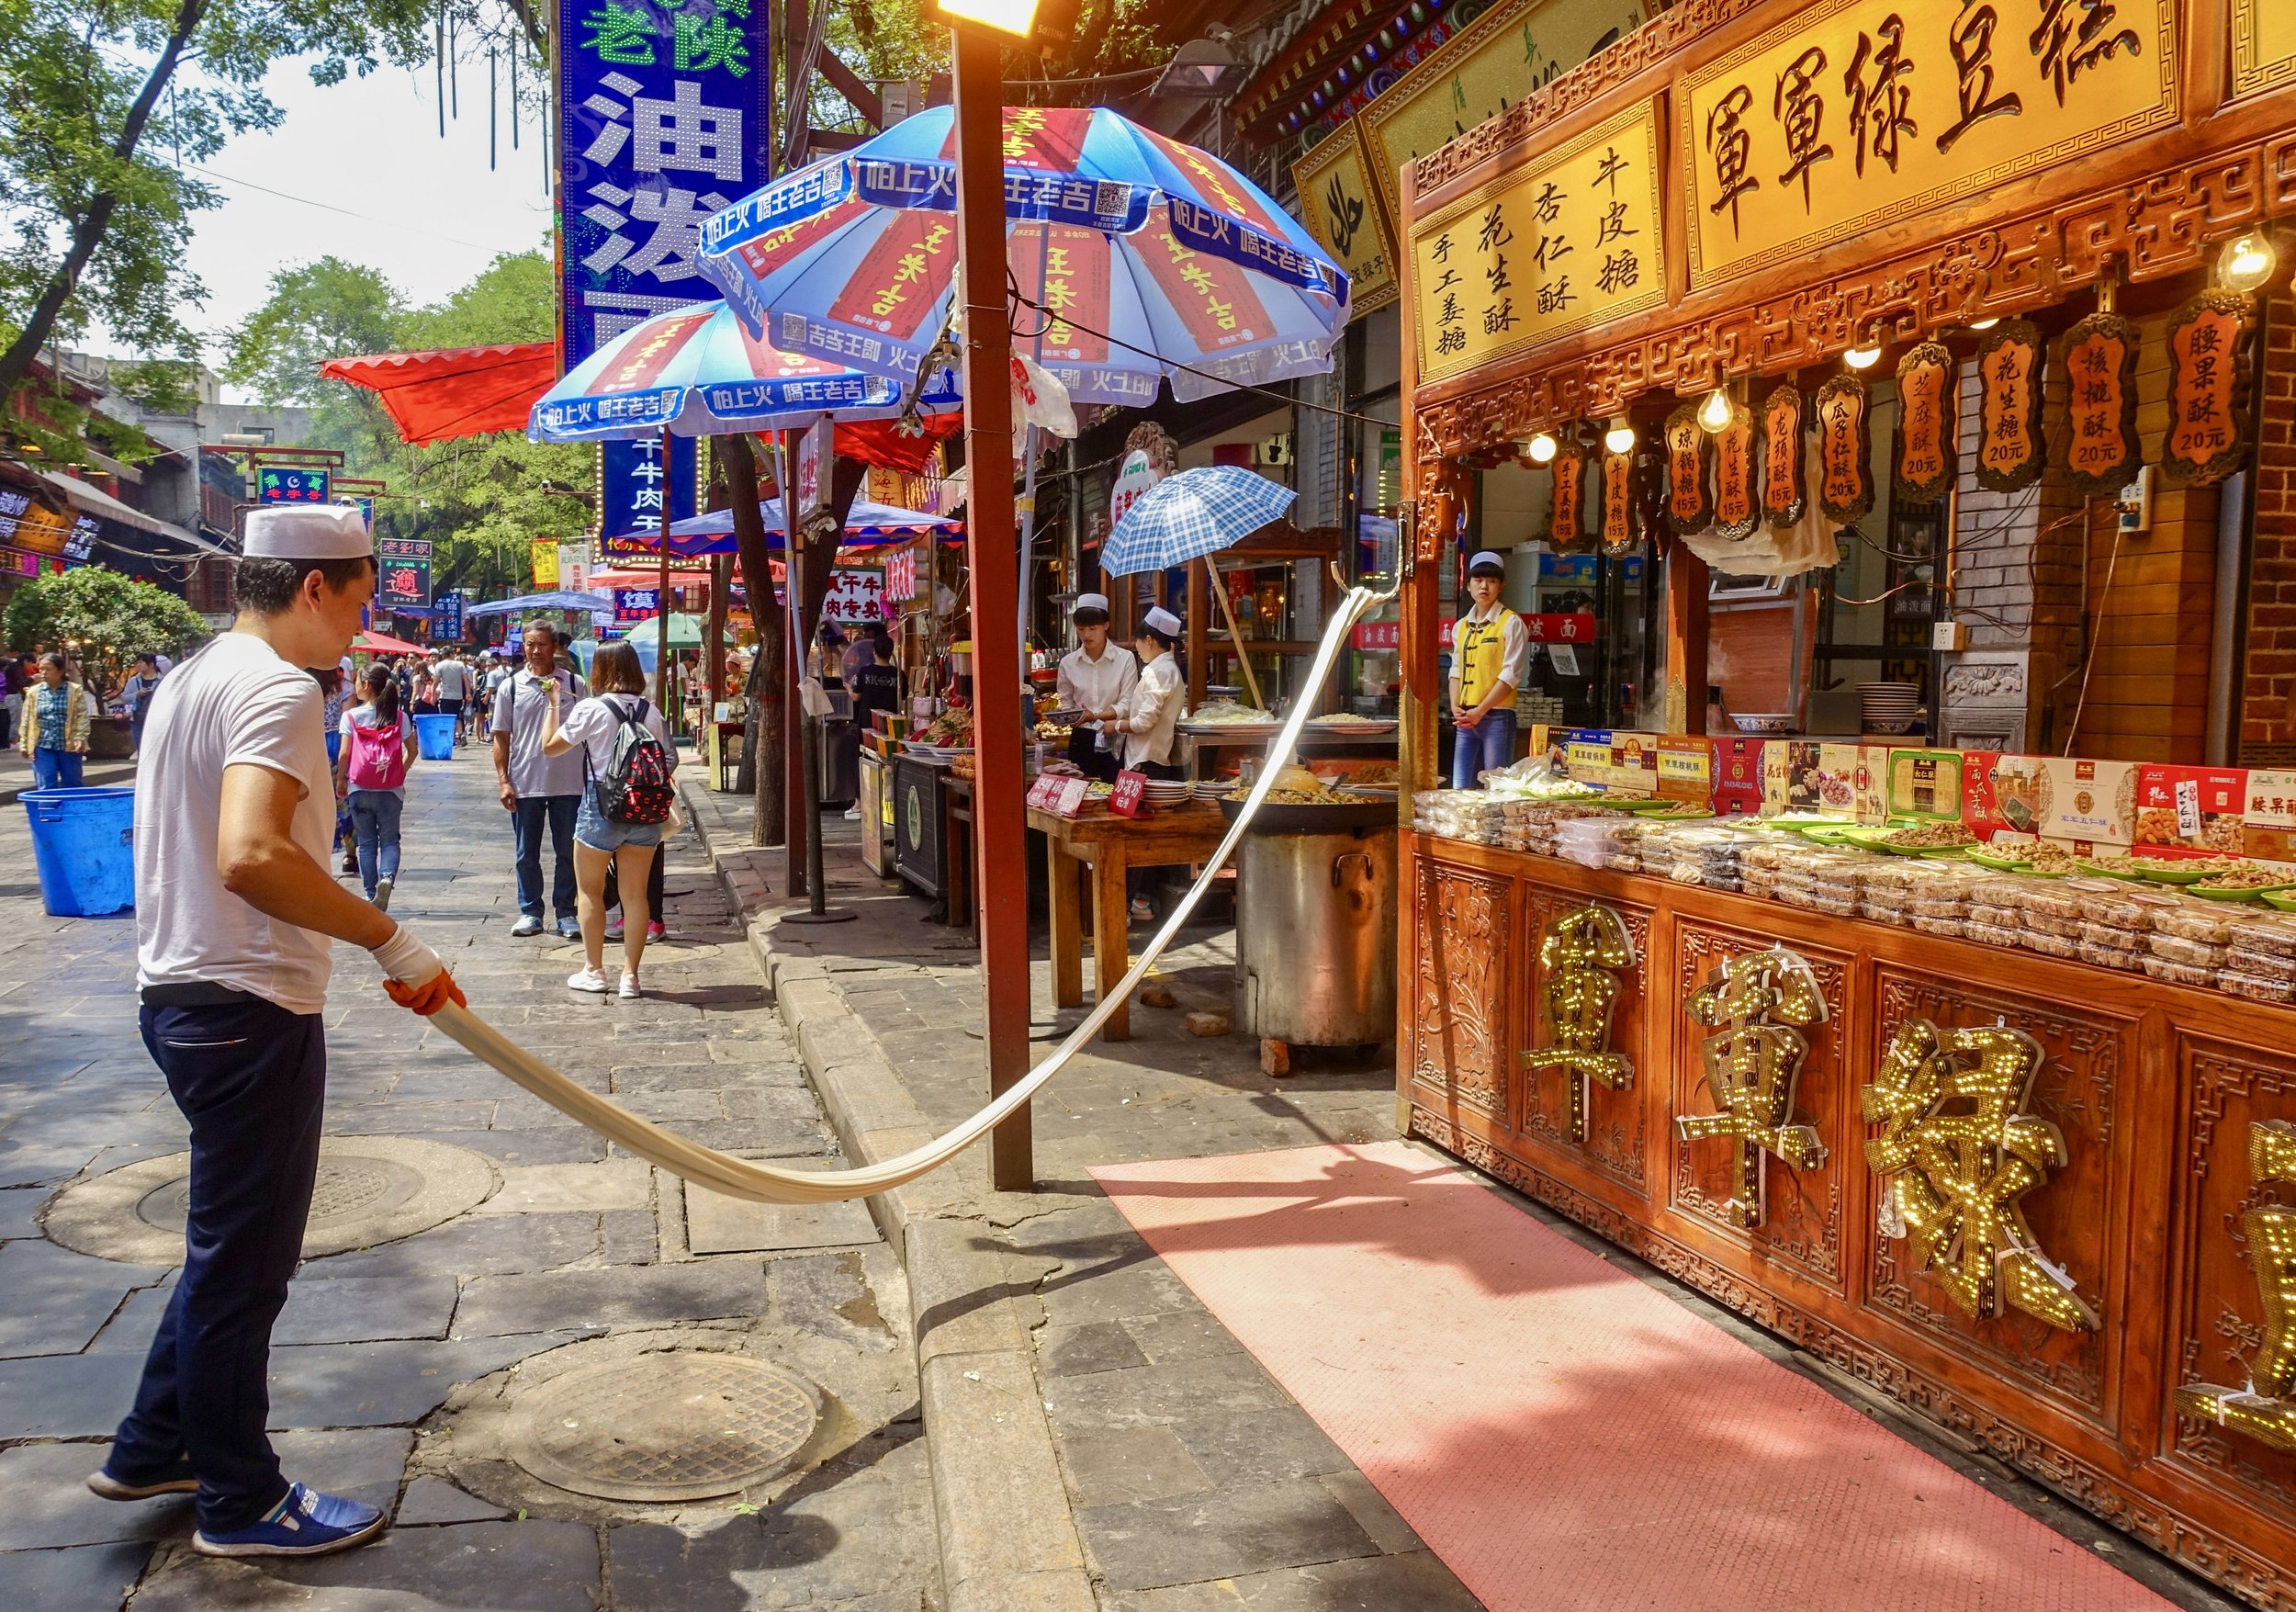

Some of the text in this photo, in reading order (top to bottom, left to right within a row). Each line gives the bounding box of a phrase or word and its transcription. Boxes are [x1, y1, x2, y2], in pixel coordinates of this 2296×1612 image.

[580, 3, 751, 79] 老陕
[706, 203, 750, 246] 怕上火
[756, 171, 822, 223] 喝王老吉
[866, 161, 957, 197] 怕上火
[1173, 198, 1319, 279] 怕上火 喝王老吉
[1532, 182, 1578, 315] 杏仁酥
[1591, 146, 1640, 295] 牛皮糖
[1431, 233, 1467, 355] 手工姜糖
[1477, 204, 1521, 335] 花生酥
[713, 379, 863, 411] 怕上火 喝王老吉
[1994, 350, 2021, 441] 花生糖
[2080, 345, 2112, 439] 核桃酥
[2186, 323, 2222, 424] 腰果酥
[546, 396, 661, 427] 怕上火 喝王老吉
[1831, 401, 1851, 478] 瓜子仁酥
[1911, 371, 1933, 452] 芝麻酥
[2180, 426, 2226, 452] 20元
[1725, 430, 1742, 499] 花生酥
[1907, 458, 1937, 475] 20元
[1989, 441, 2024, 462] 20元
[2077, 444, 2118, 464] 20元
[1609, 457, 1624, 523] 牛皮糖
[1675, 497, 1698, 512] 15元
[1722, 502, 1745, 516] 15元
[1771, 488, 1791, 502] 15元
[1829, 480, 1856, 498] 20元
[1555, 524, 1572, 536] 15元
[1607, 524, 1625, 536] 15元
